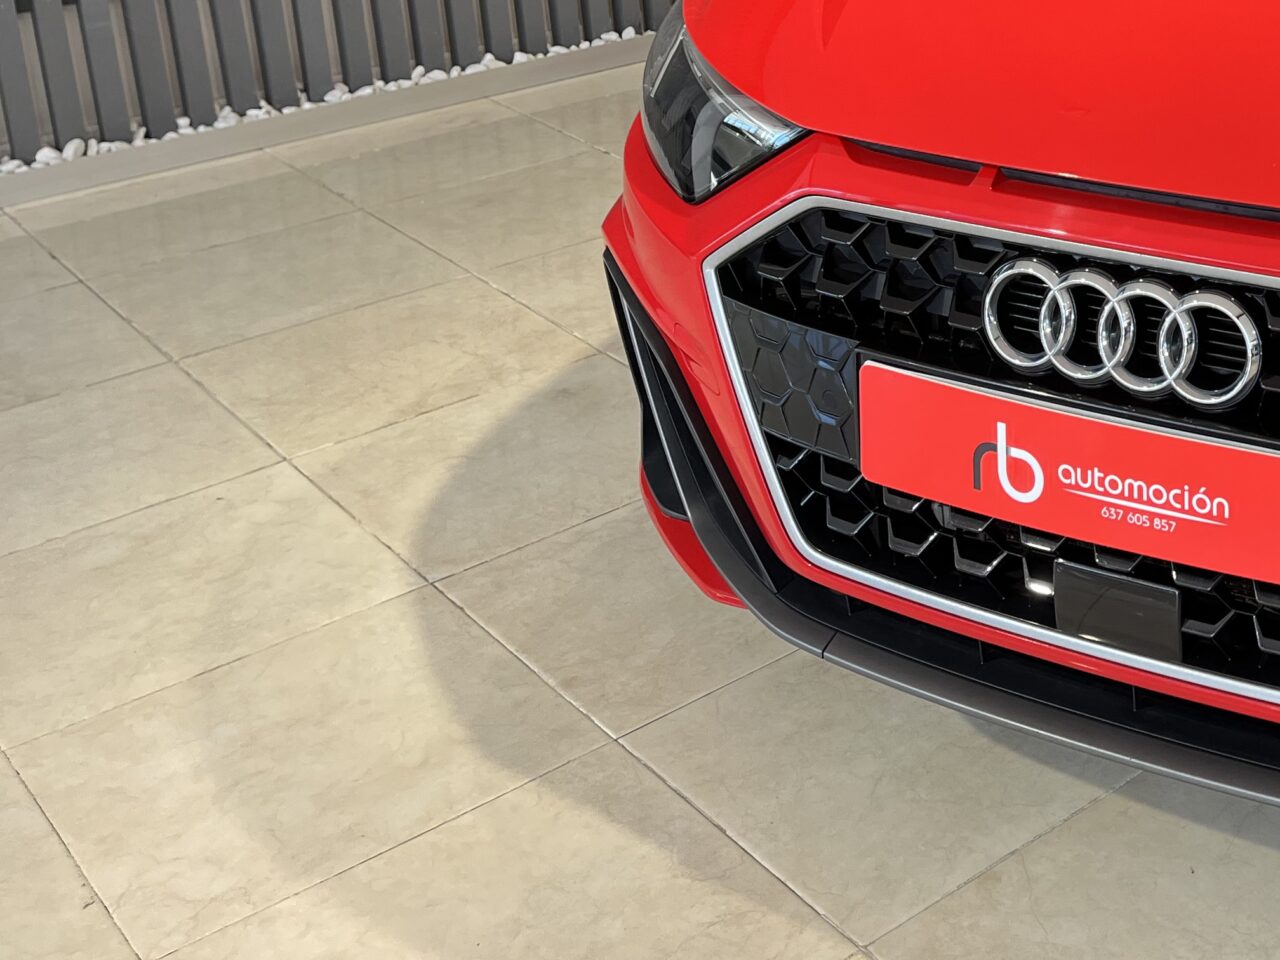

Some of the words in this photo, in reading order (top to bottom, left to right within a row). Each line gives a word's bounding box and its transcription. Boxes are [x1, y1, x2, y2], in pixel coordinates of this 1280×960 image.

[1057, 464, 1229, 518] automoción
[1100, 506, 1123, 520] 637
[1127, 512, 1150, 527] 605
[1153, 517, 1176, 532] 857
